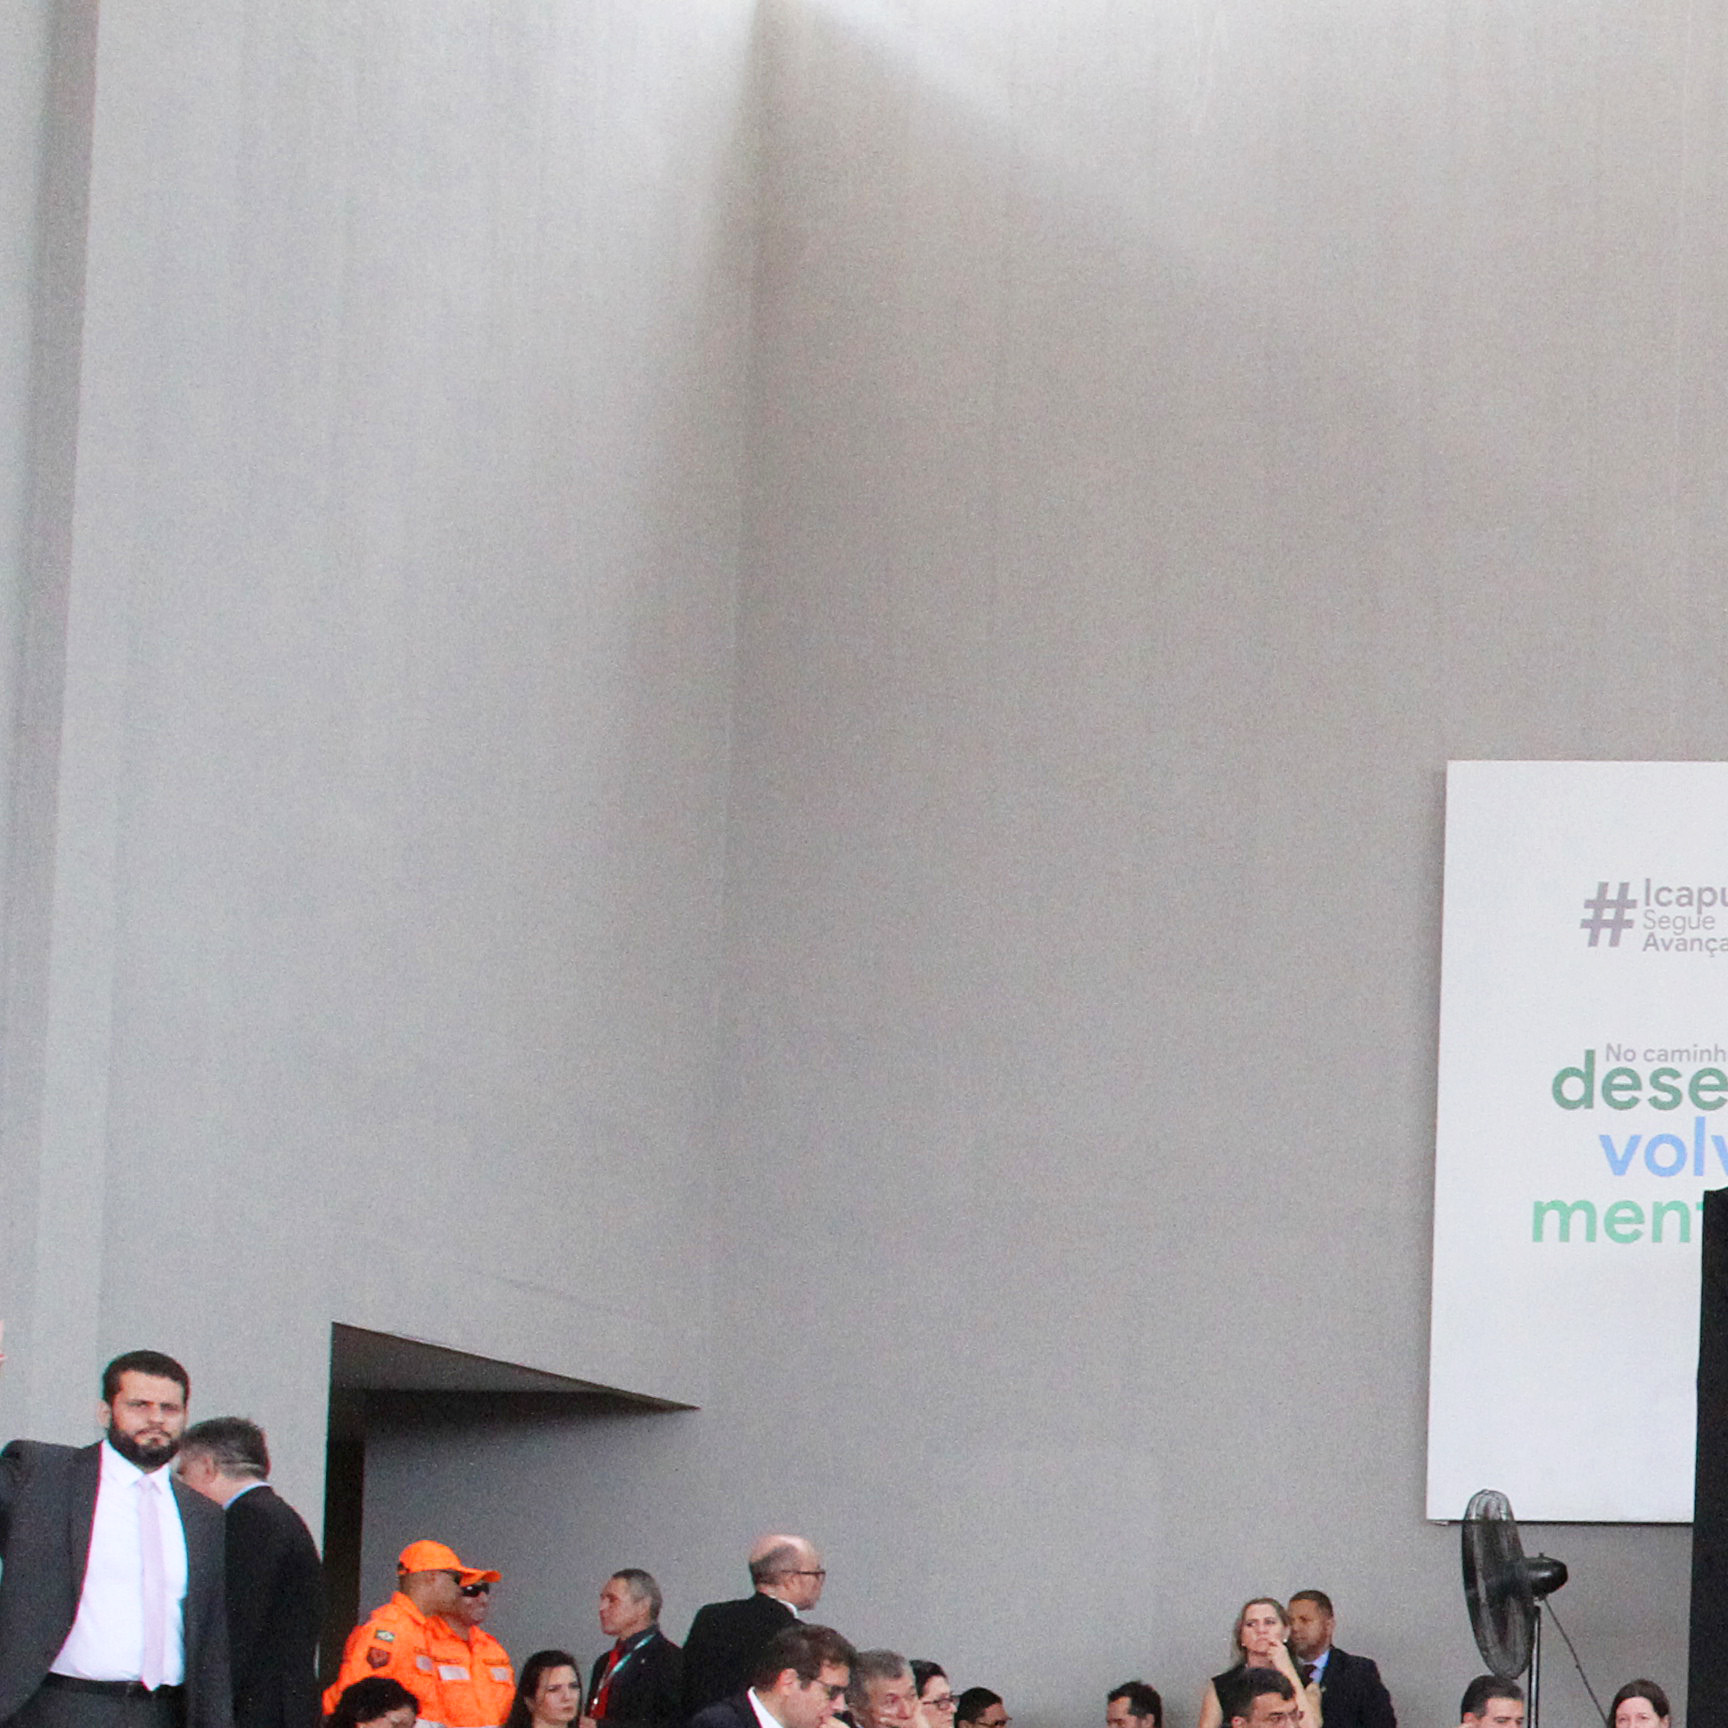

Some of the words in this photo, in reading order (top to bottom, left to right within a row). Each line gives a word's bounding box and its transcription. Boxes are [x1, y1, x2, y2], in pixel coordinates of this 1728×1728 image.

[1643, 910, 1715, 935] Segue
[1606, 1043, 1636, 1062] No
[1532, 1199, 1704, 1243] men
